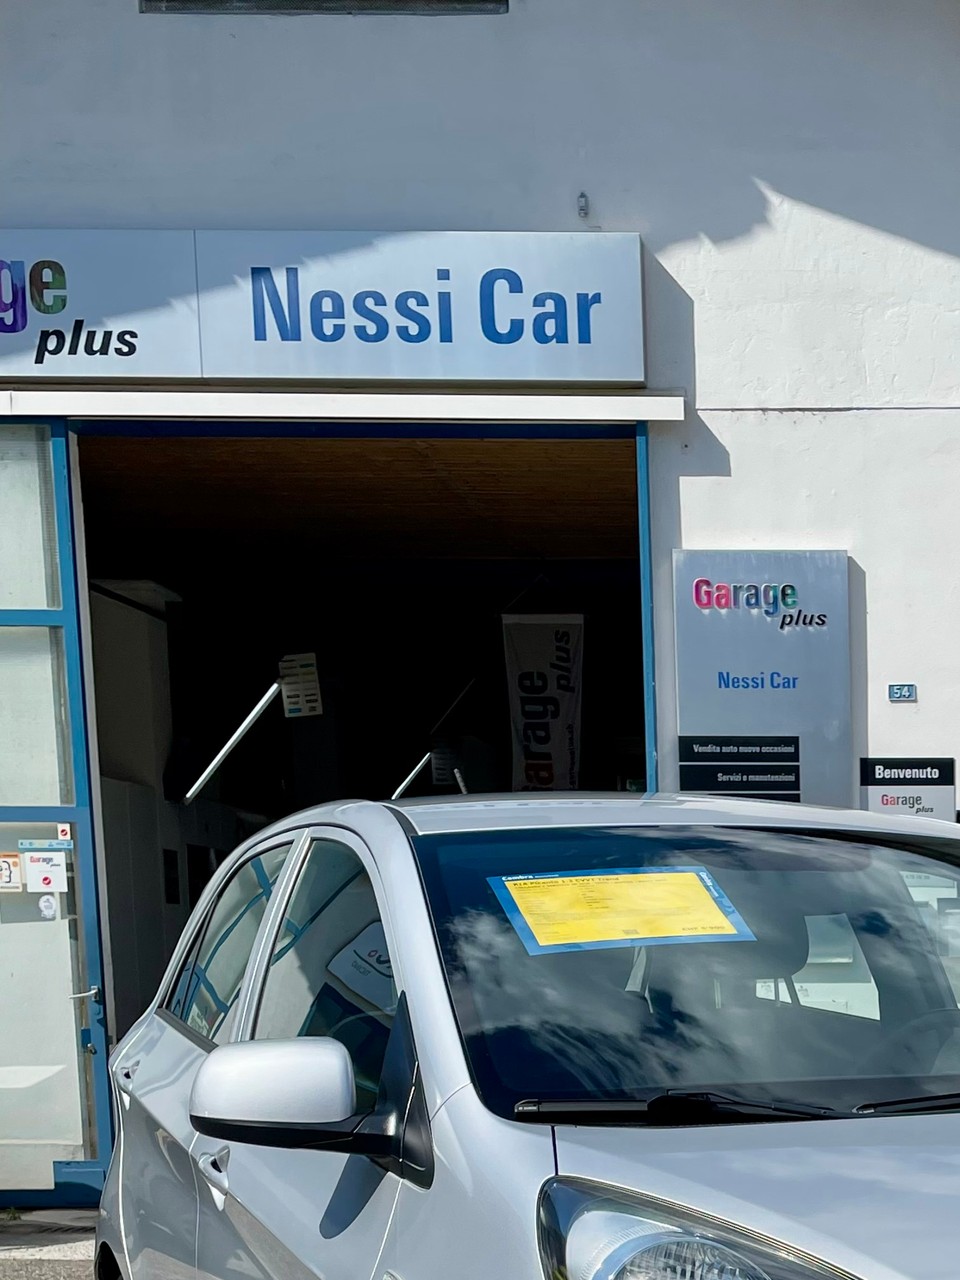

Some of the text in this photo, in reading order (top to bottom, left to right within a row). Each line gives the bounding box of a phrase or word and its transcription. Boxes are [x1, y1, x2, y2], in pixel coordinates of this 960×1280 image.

[249, 266, 602, 345] Nessi Car
[34, 319, 139, 365] plus
[693, 577, 799, 616] Garage
[779, 610, 827, 630] plus
[550, 629, 576, 694] plus
[717, 671, 799, 690] Nessi Car
[893, 686, 910, 698] 54
[517, 671, 560, 791] arage
[693, 744, 720, 753] Vendita
[717, 773, 742, 782] Servizi
[875, 765, 940, 780] Benvenuto
[881, 794, 922, 808] Garage
[915, 805, 934, 814] plus
